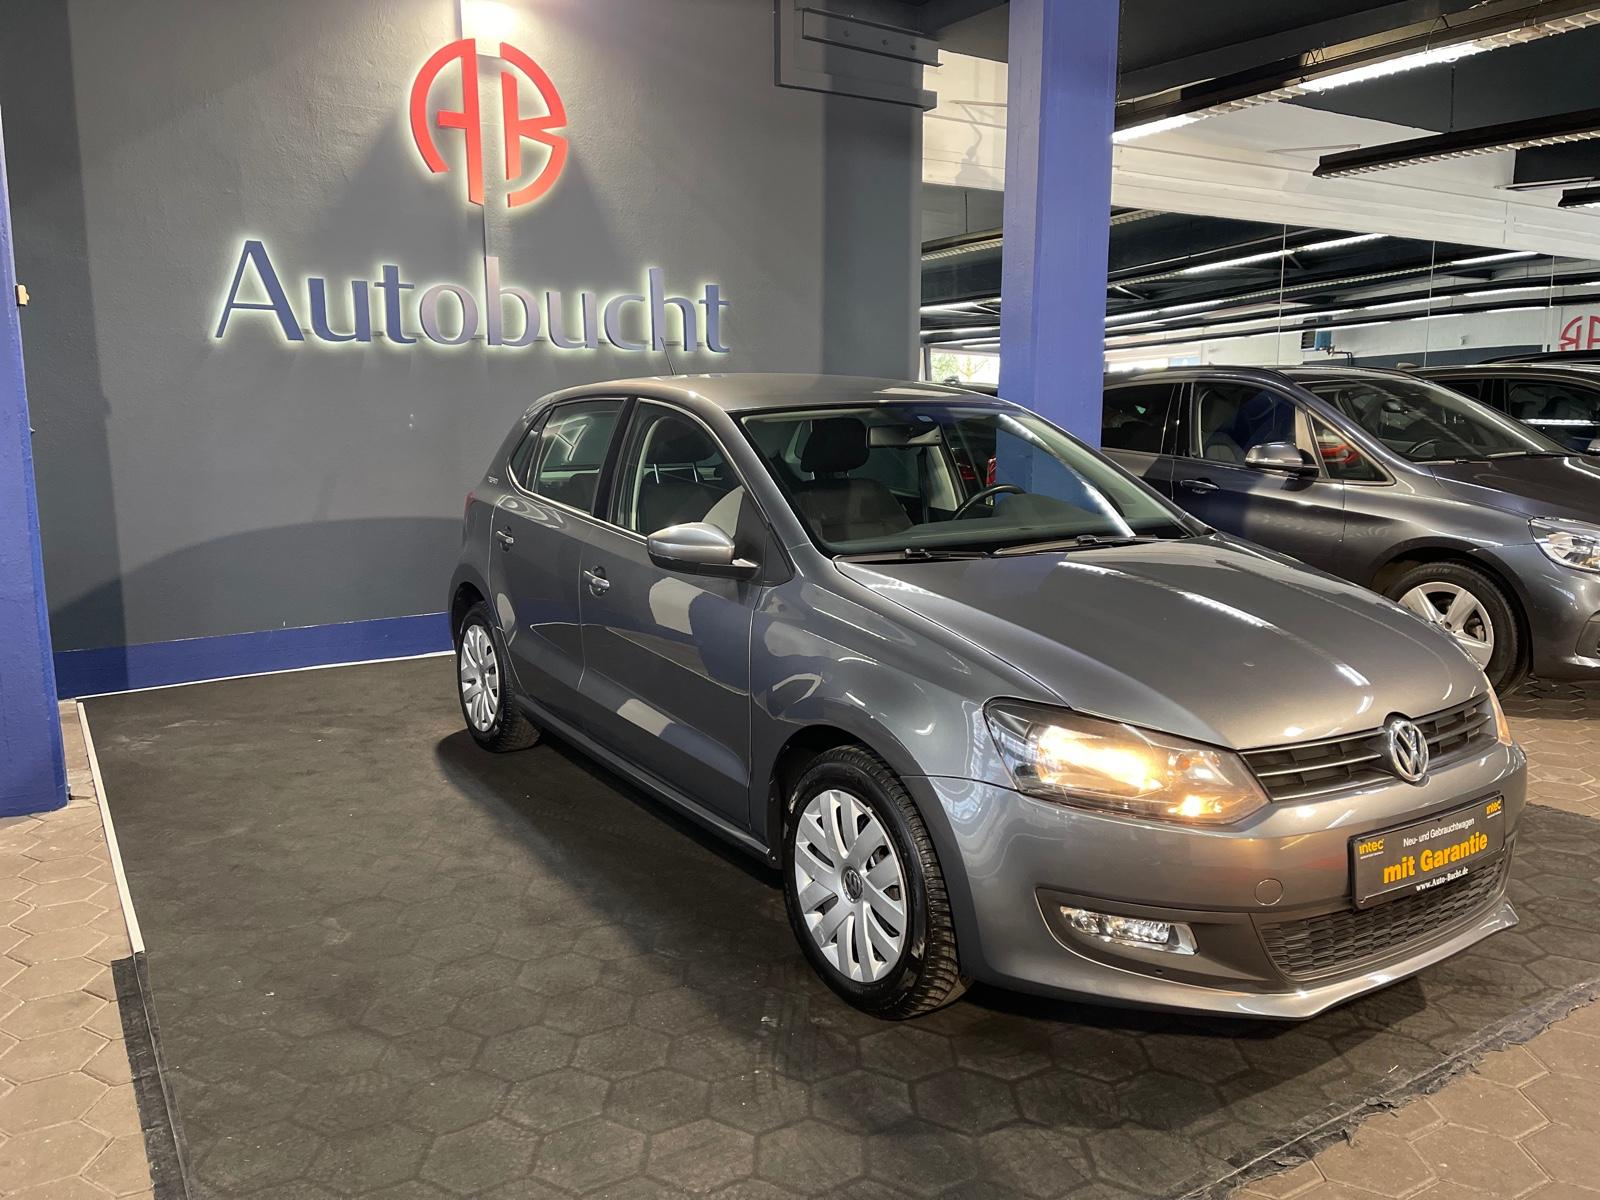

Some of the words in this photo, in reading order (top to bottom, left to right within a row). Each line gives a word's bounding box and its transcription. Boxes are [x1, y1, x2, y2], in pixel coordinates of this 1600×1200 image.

[410, 38, 567, 207] AB
[215, 240, 731, 354] Autobucht
[1359, 839, 1385, 855] intec
[1403, 837, 1417, 848] Neu-
[1419, 832, 1430, 843] und
[1430, 817, 1475, 838] Gebrauchtwagen
[1383, 855, 1417, 884] mit
[1420, 831, 1488, 872] Garantie
[1415, 866, 1469, 891] www.Auto-Bucht.de
